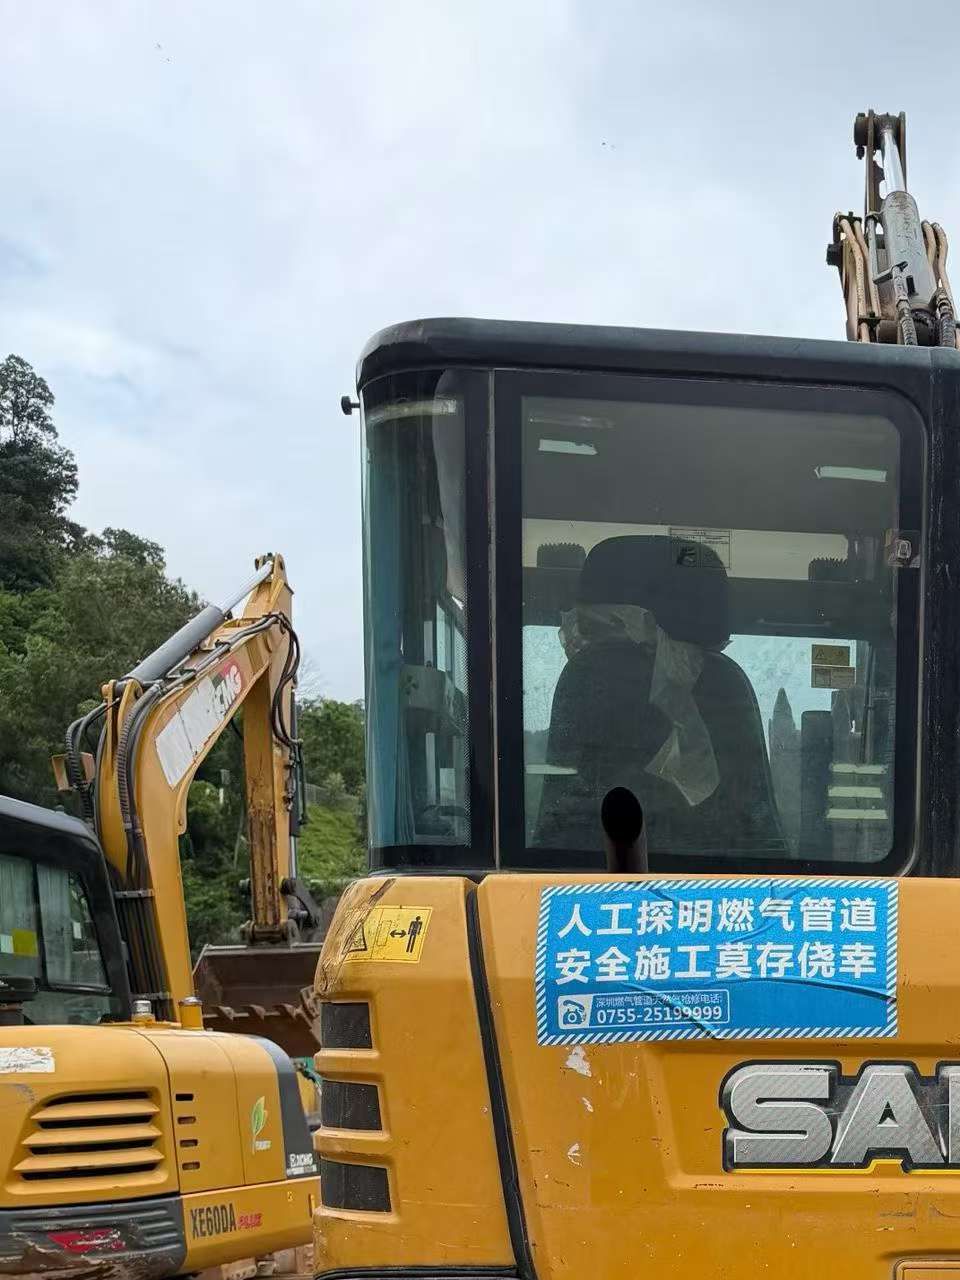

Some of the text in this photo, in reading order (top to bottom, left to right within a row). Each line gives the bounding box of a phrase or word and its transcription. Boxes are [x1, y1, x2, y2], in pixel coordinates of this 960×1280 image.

[556, 896, 878, 939] 人工探明燃气管道
[554, 941, 878, 985] 安全施工莫存侥幸
[596, 1006, 723, 1024] 0755-25199999
